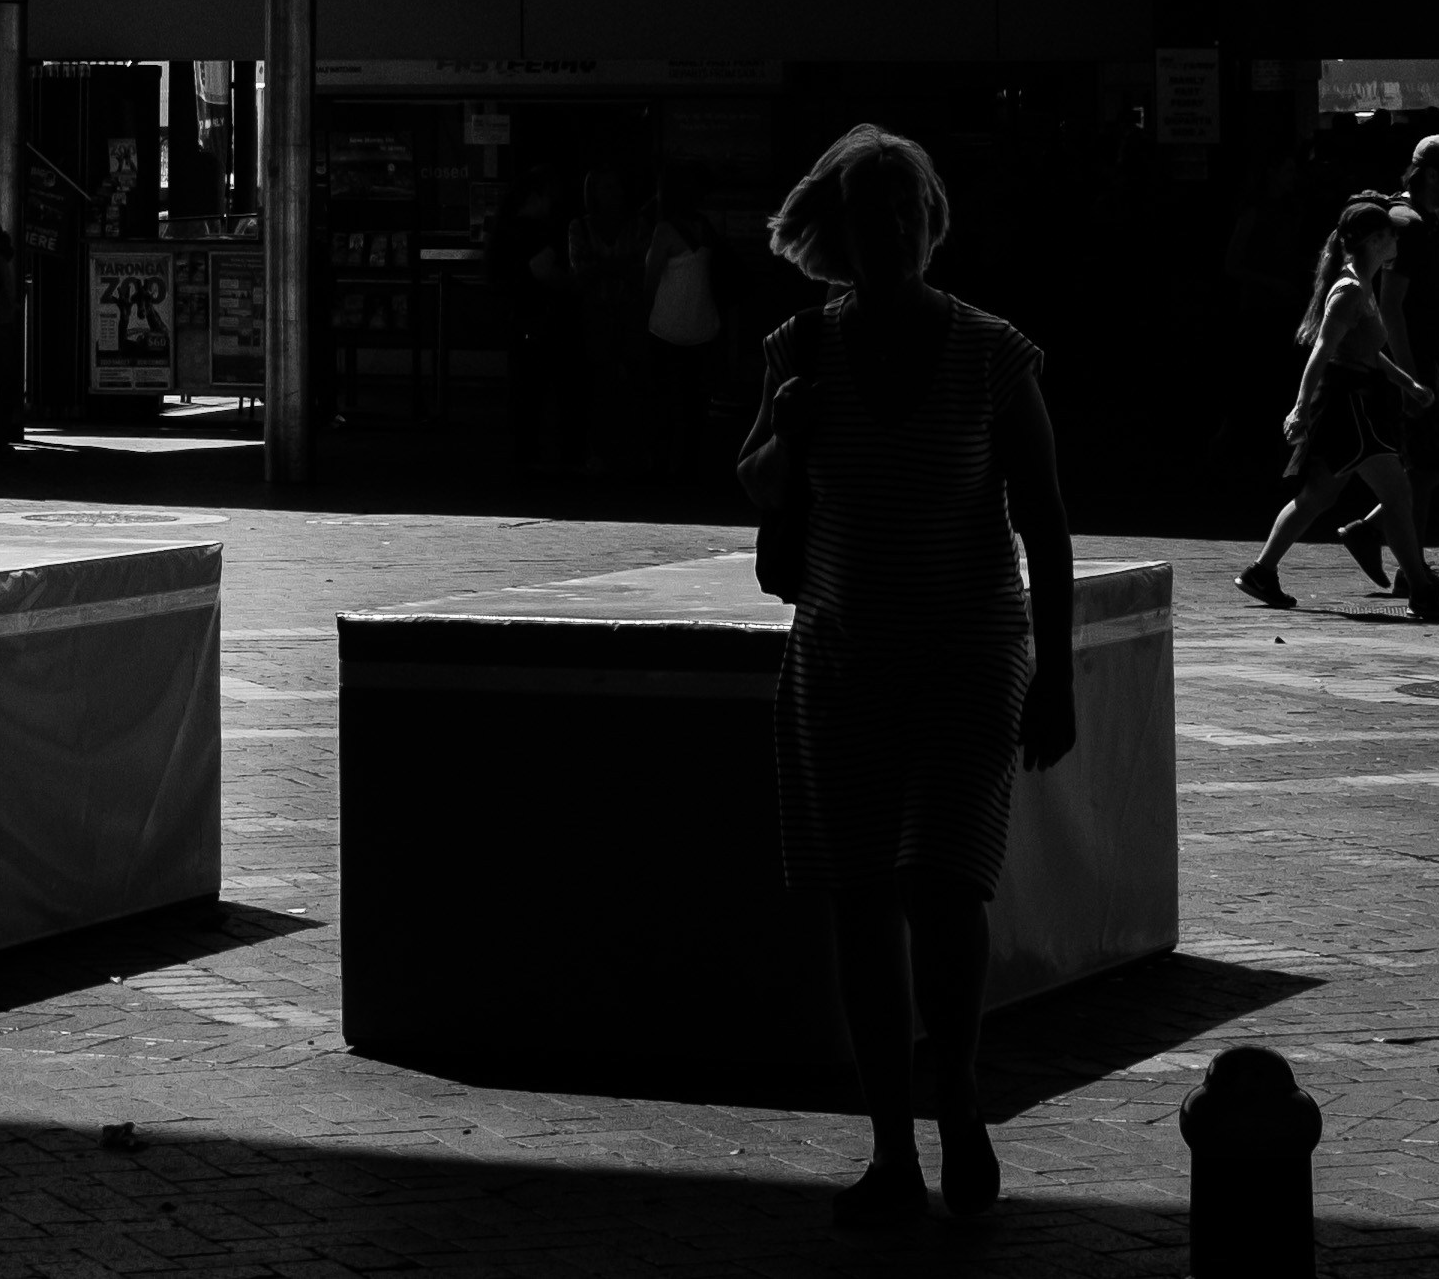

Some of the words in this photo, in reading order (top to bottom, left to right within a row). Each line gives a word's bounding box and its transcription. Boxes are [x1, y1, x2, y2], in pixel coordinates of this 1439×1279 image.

[421, 163, 469, 180] closed
[98, 262, 166, 276] TARONGA
[99, 276, 168, 305] ZOO
